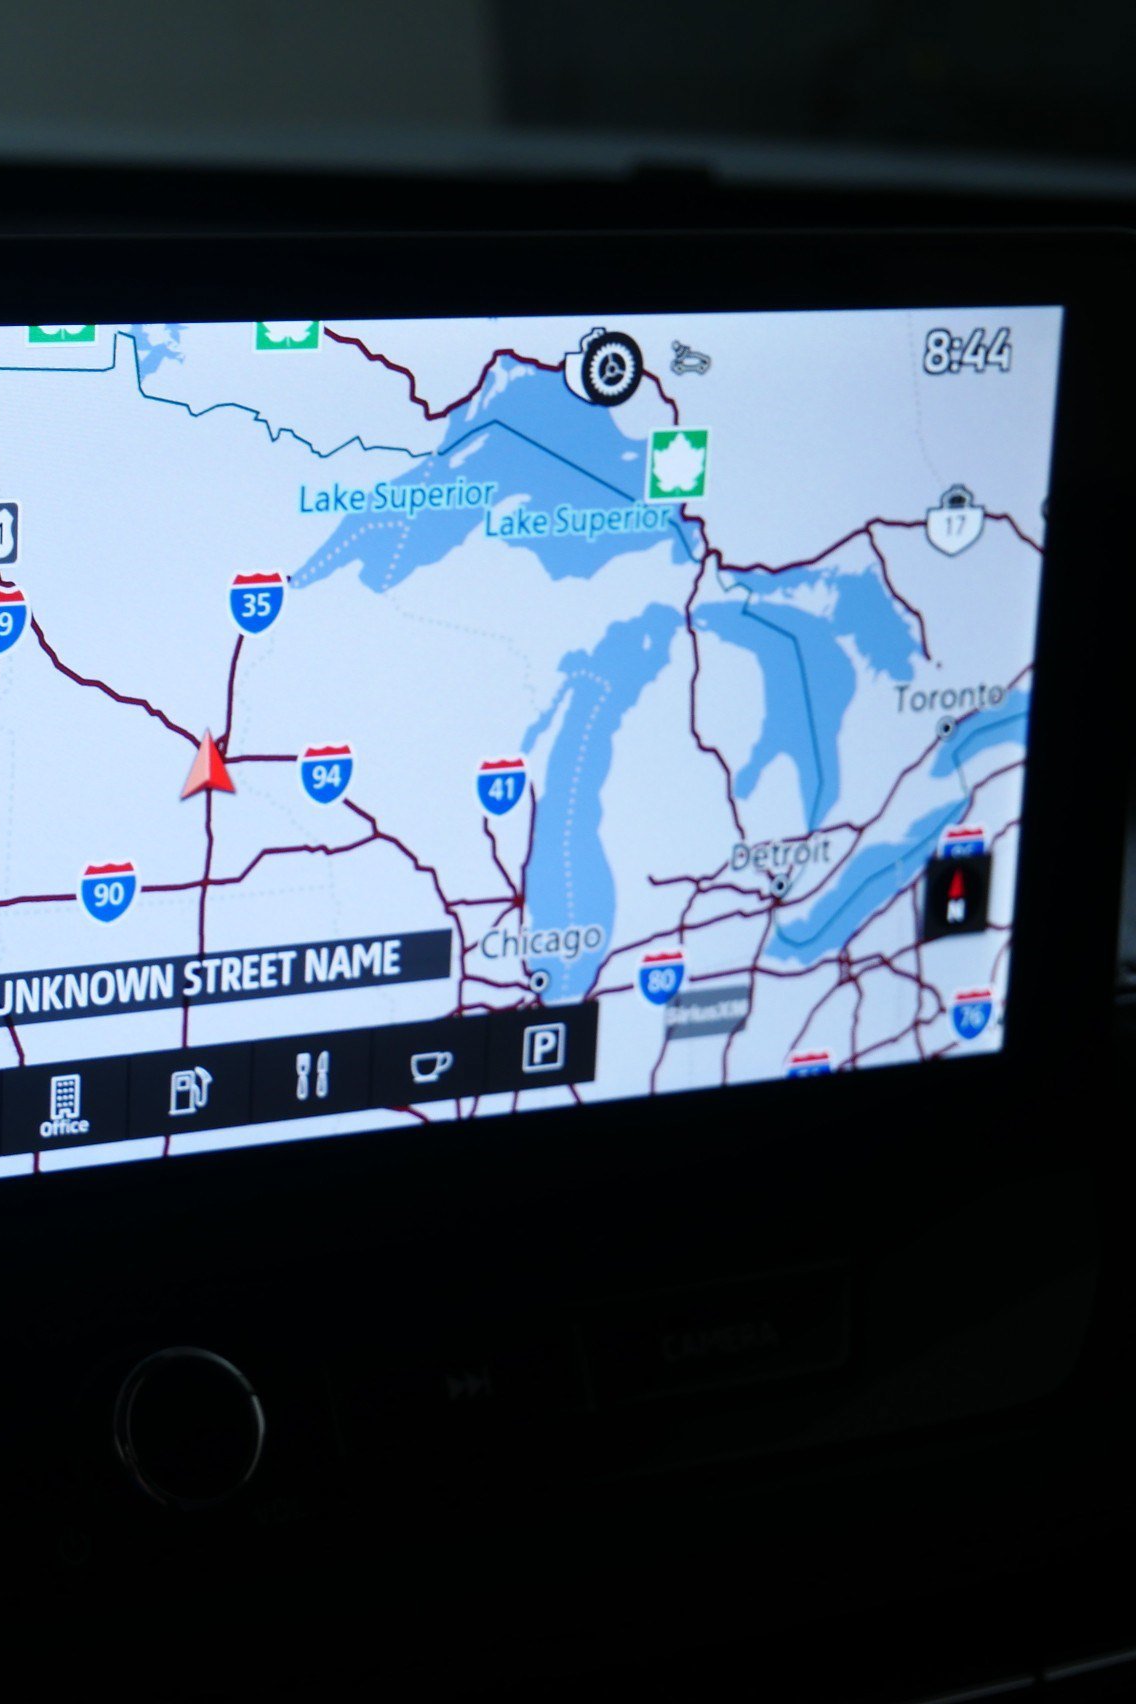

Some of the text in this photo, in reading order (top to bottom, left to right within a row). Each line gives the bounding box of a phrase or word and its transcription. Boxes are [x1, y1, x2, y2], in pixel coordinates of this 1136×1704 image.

[924, 327, 1012, 375] 8:44
[300, 476, 495, 517] Lake Superior
[485, 502, 670, 539] Lake Superior
[945, 516, 966, 537] 17
[241, 592, 272, 617] 35
[895, 683, 1005, 712] Toronto
[311, 764, 342, 788] 94
[488, 777, 515, 801] 41
[730, 838, 831, 872] Detroit
[93, 883, 125, 907] 90
[947, 898, 965, 923] N
[481, 926, 602, 959] Chicago
[182, 950, 297, 997] STREET
[304, 939, 402, 983] NAME
[647, 967, 676, 994] 80
[533, 1031, 557, 1064] P
[39, 1117, 90, 1138] Office
